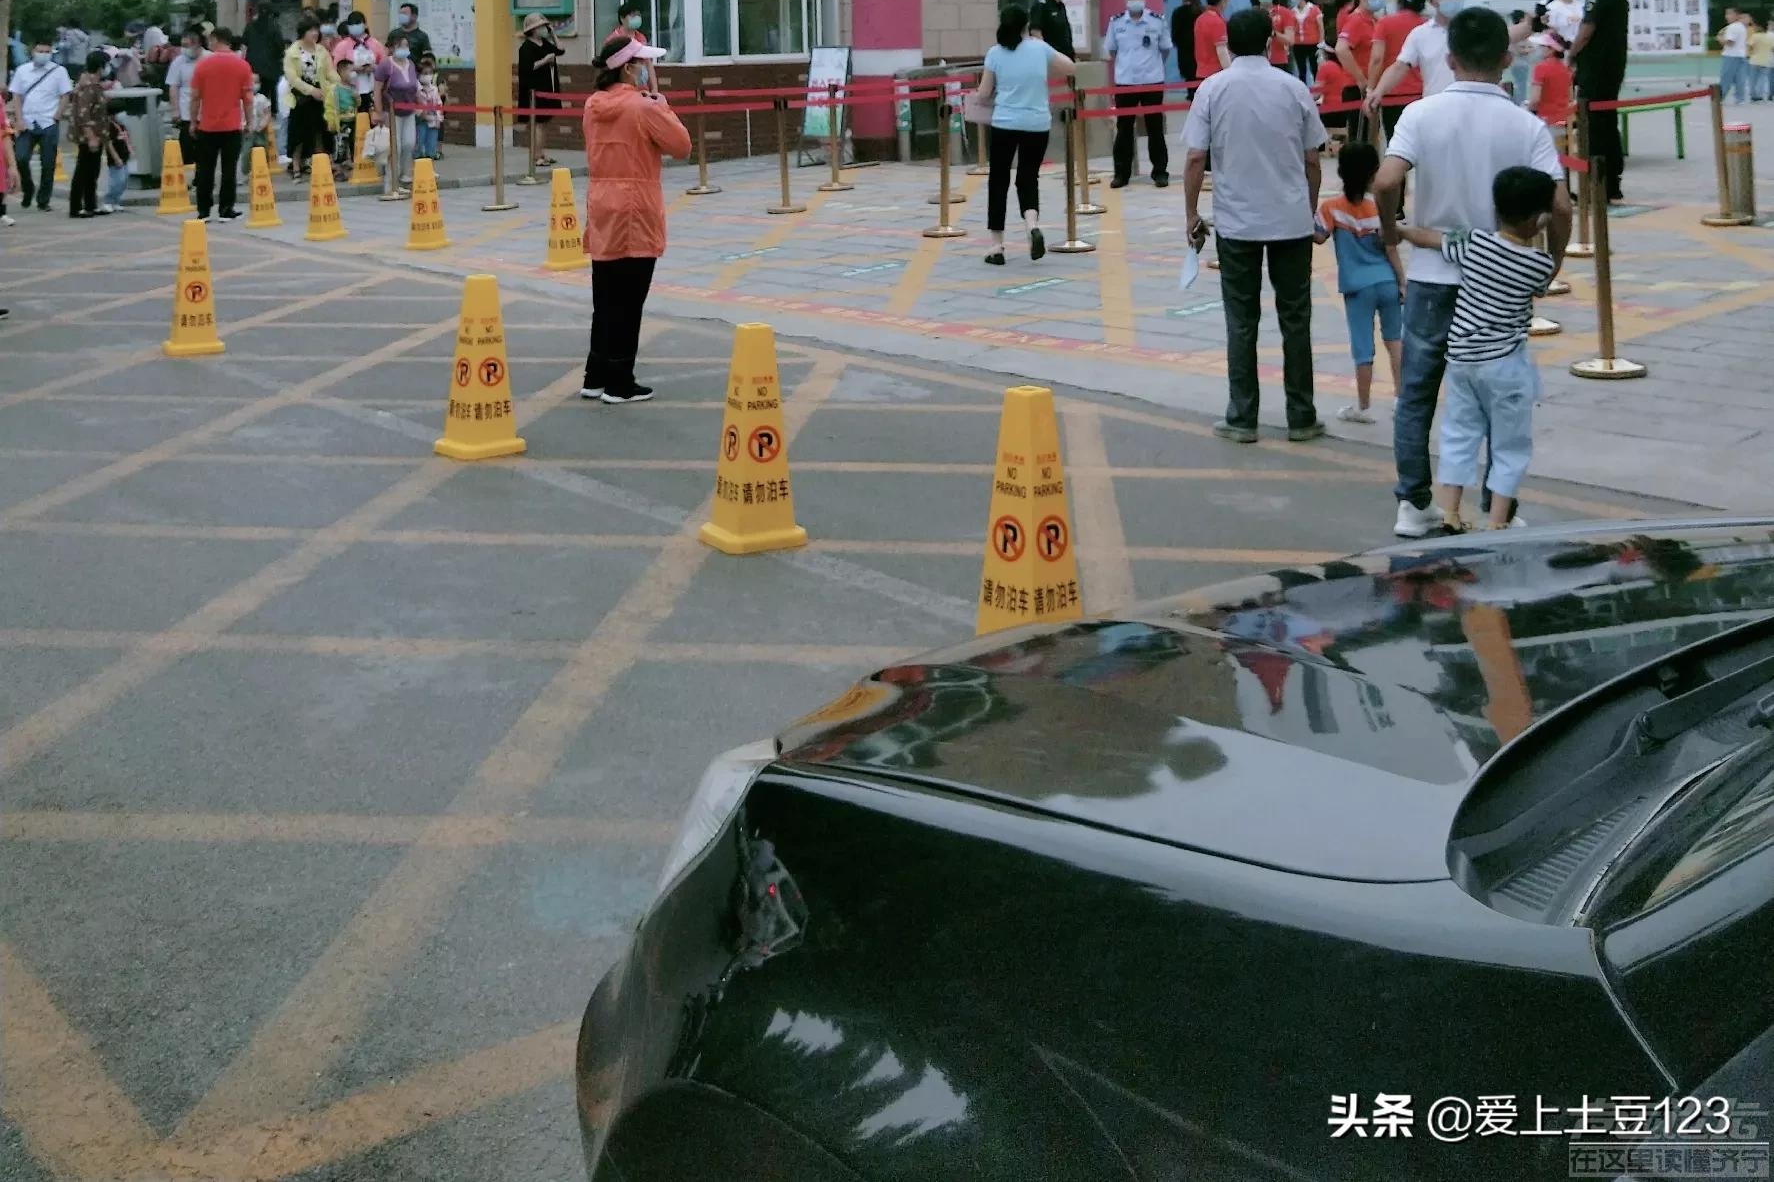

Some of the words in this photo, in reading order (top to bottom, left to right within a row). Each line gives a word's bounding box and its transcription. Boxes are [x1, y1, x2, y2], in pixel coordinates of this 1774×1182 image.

[757, 386, 768, 397] NO
[747, 399, 778, 411] PARKING
[1006, 466, 1017, 480] NO
[1041, 466, 1052, 480] NO
[743, 478, 788, 505] 请勿泊车
[995, 480, 1027, 499] PARKING
[1033, 481, 1063, 499] PARKING
[984, 578, 1029, 616] 请勿泊车
[1034, 579, 1078, 616] 请勿泊车
